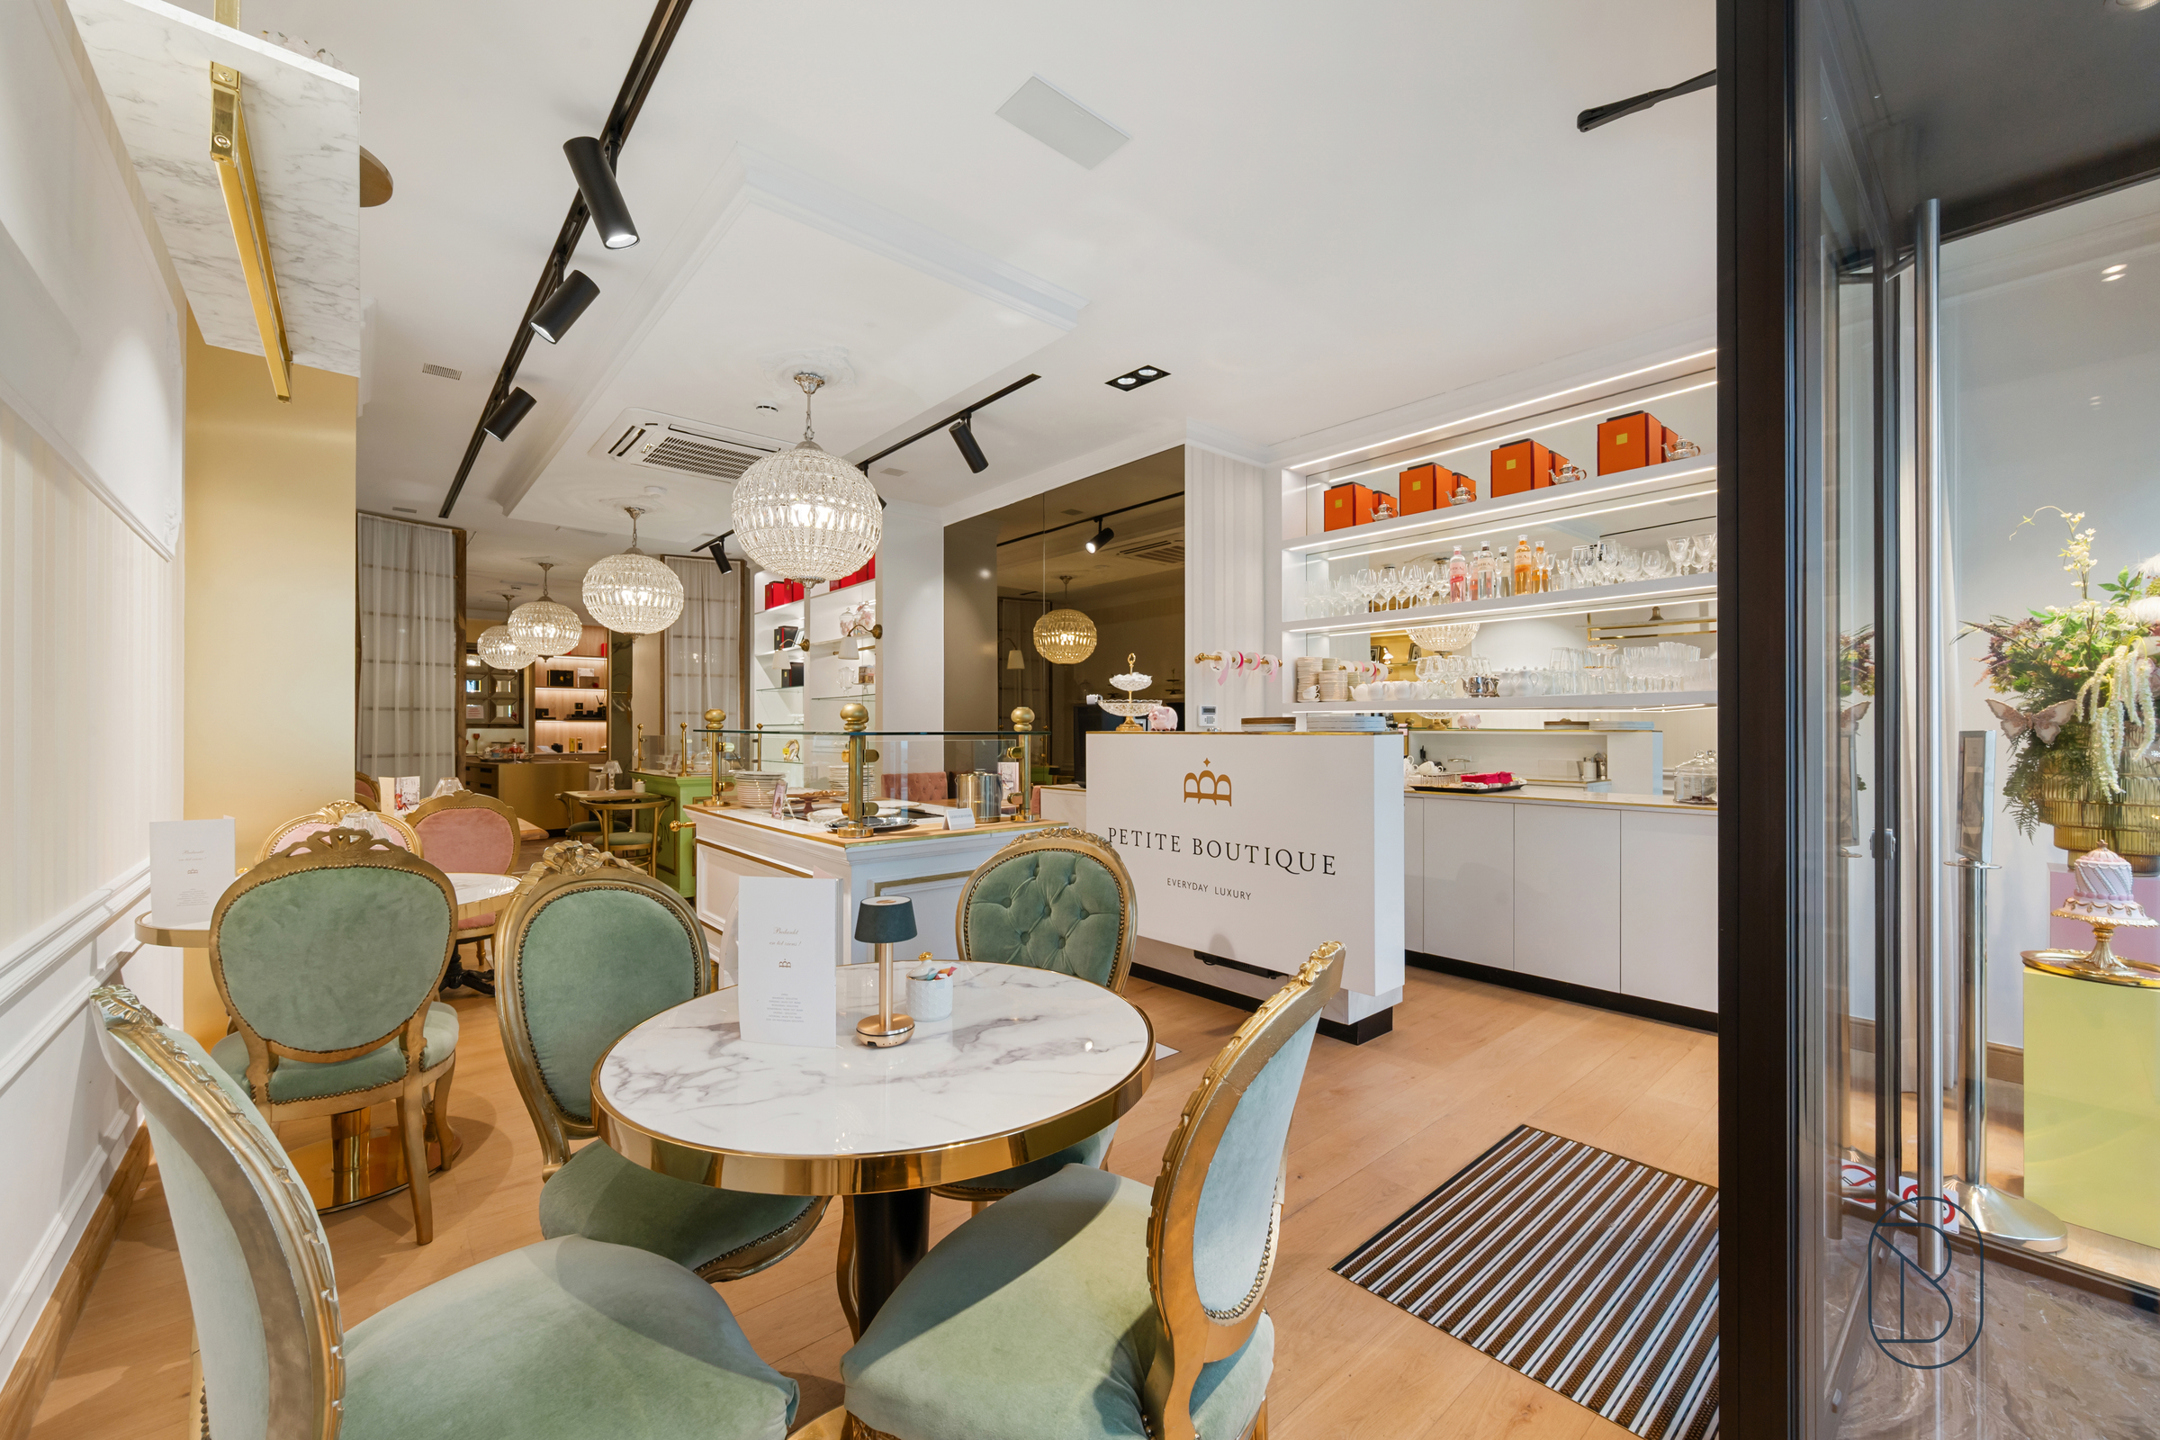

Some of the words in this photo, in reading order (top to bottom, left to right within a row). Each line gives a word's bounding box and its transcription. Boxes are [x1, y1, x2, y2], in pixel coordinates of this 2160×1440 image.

[1108, 827, 1181, 853] PETITE
[1193, 837, 1337, 876] BOUTIQUE
[1166, 877, 1209, 893] EVERYDAY
[1214, 886, 1252, 901] LUXURY
